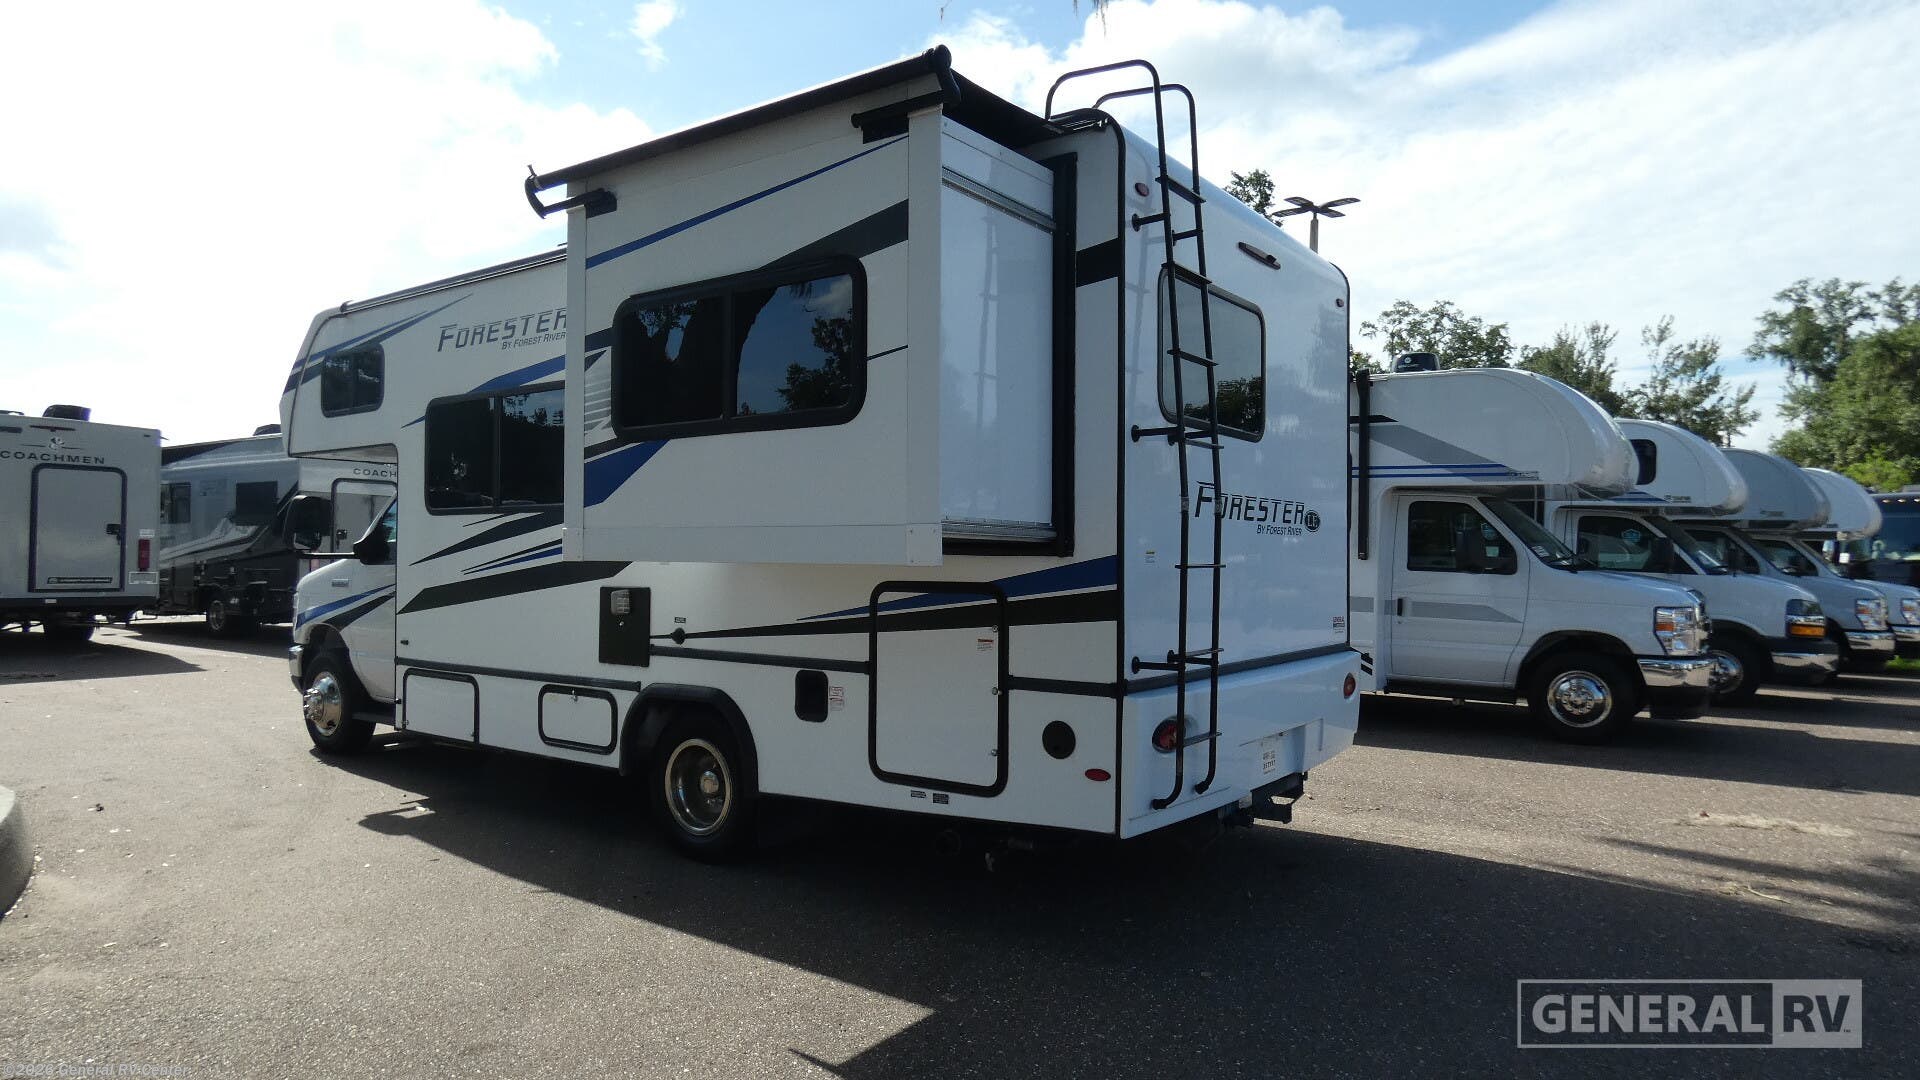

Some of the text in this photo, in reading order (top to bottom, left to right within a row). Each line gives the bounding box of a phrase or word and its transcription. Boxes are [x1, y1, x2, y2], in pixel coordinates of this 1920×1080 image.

[437, 307, 567, 352] FORESTER
[0, 450, 105, 464] COACHMEN
[1256, 524, 1266, 534] BY
[1266, 524, 1287, 535] FOREST
